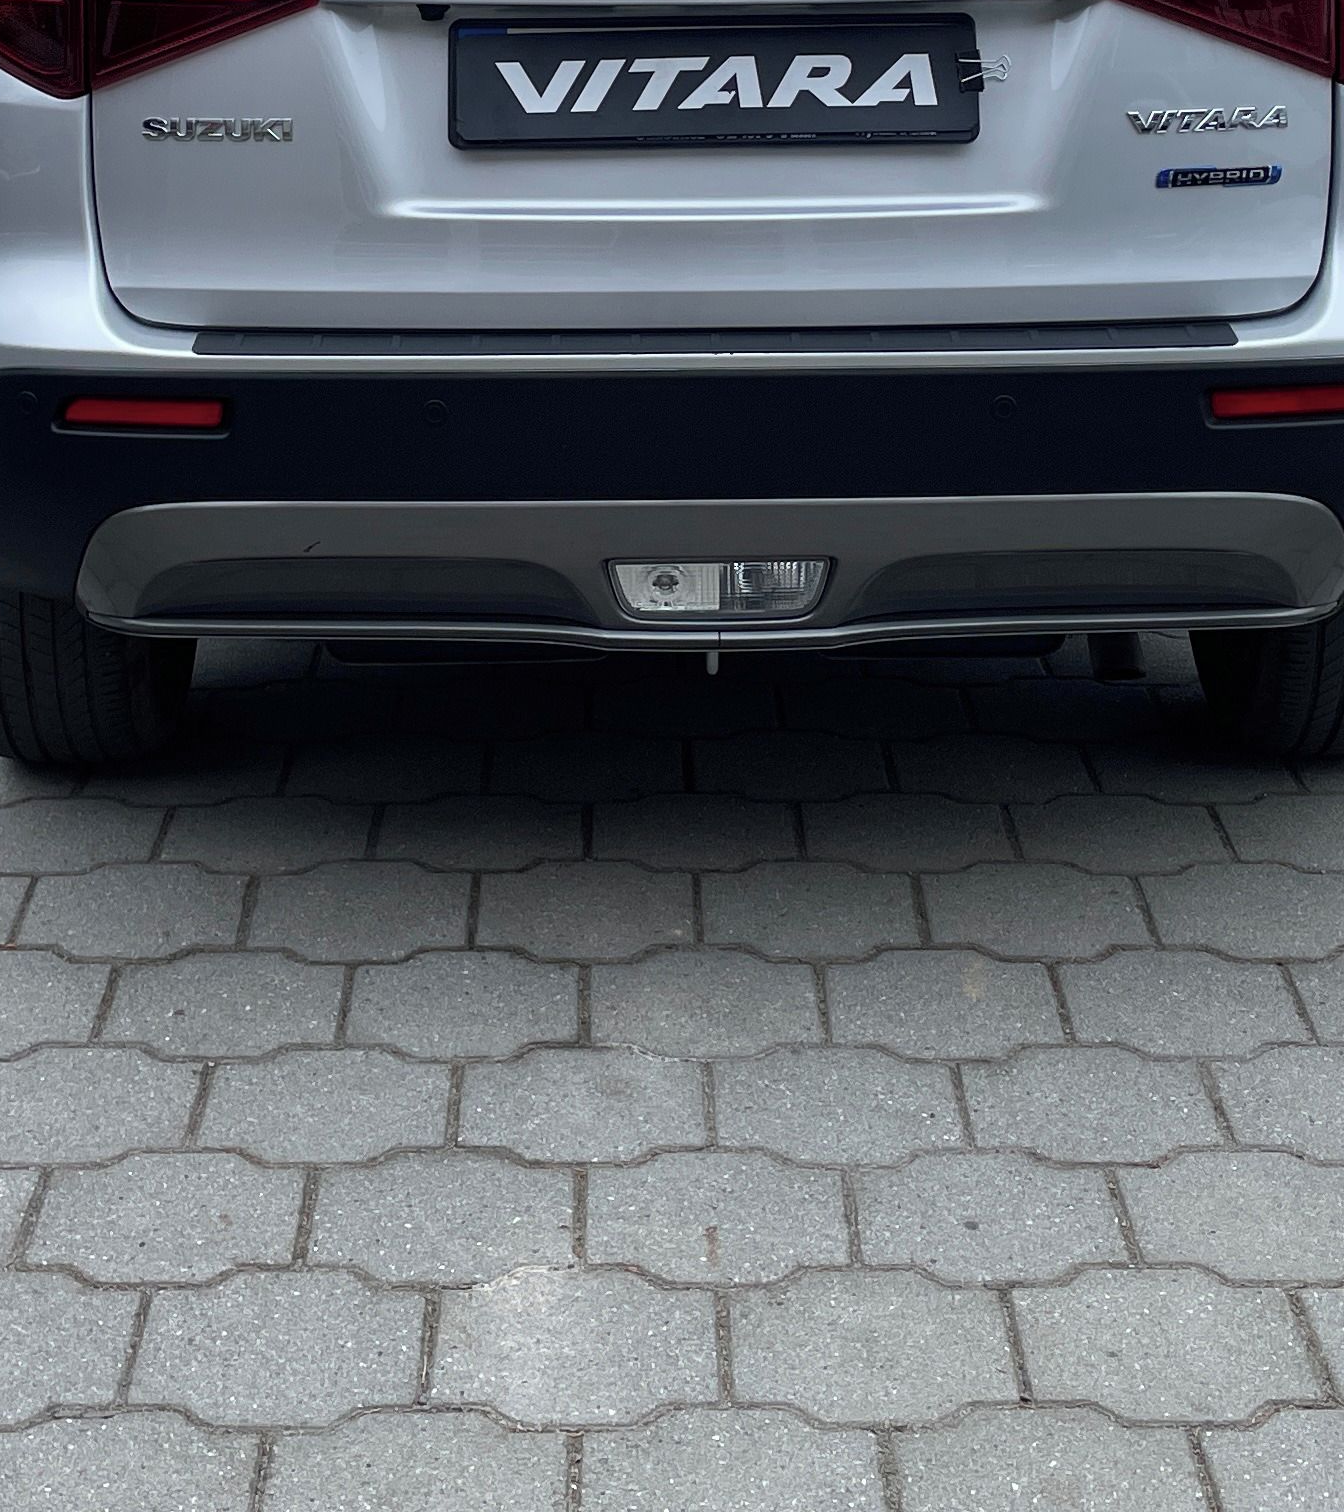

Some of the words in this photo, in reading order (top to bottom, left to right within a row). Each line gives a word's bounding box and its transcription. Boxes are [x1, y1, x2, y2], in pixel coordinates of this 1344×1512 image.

[494, 53, 939, 114] VITARA
[142, 116, 293, 142] SUZUKI
[1125, 105, 1289, 135] VITARA
[1176, 168, 1265, 186] HYBRID
